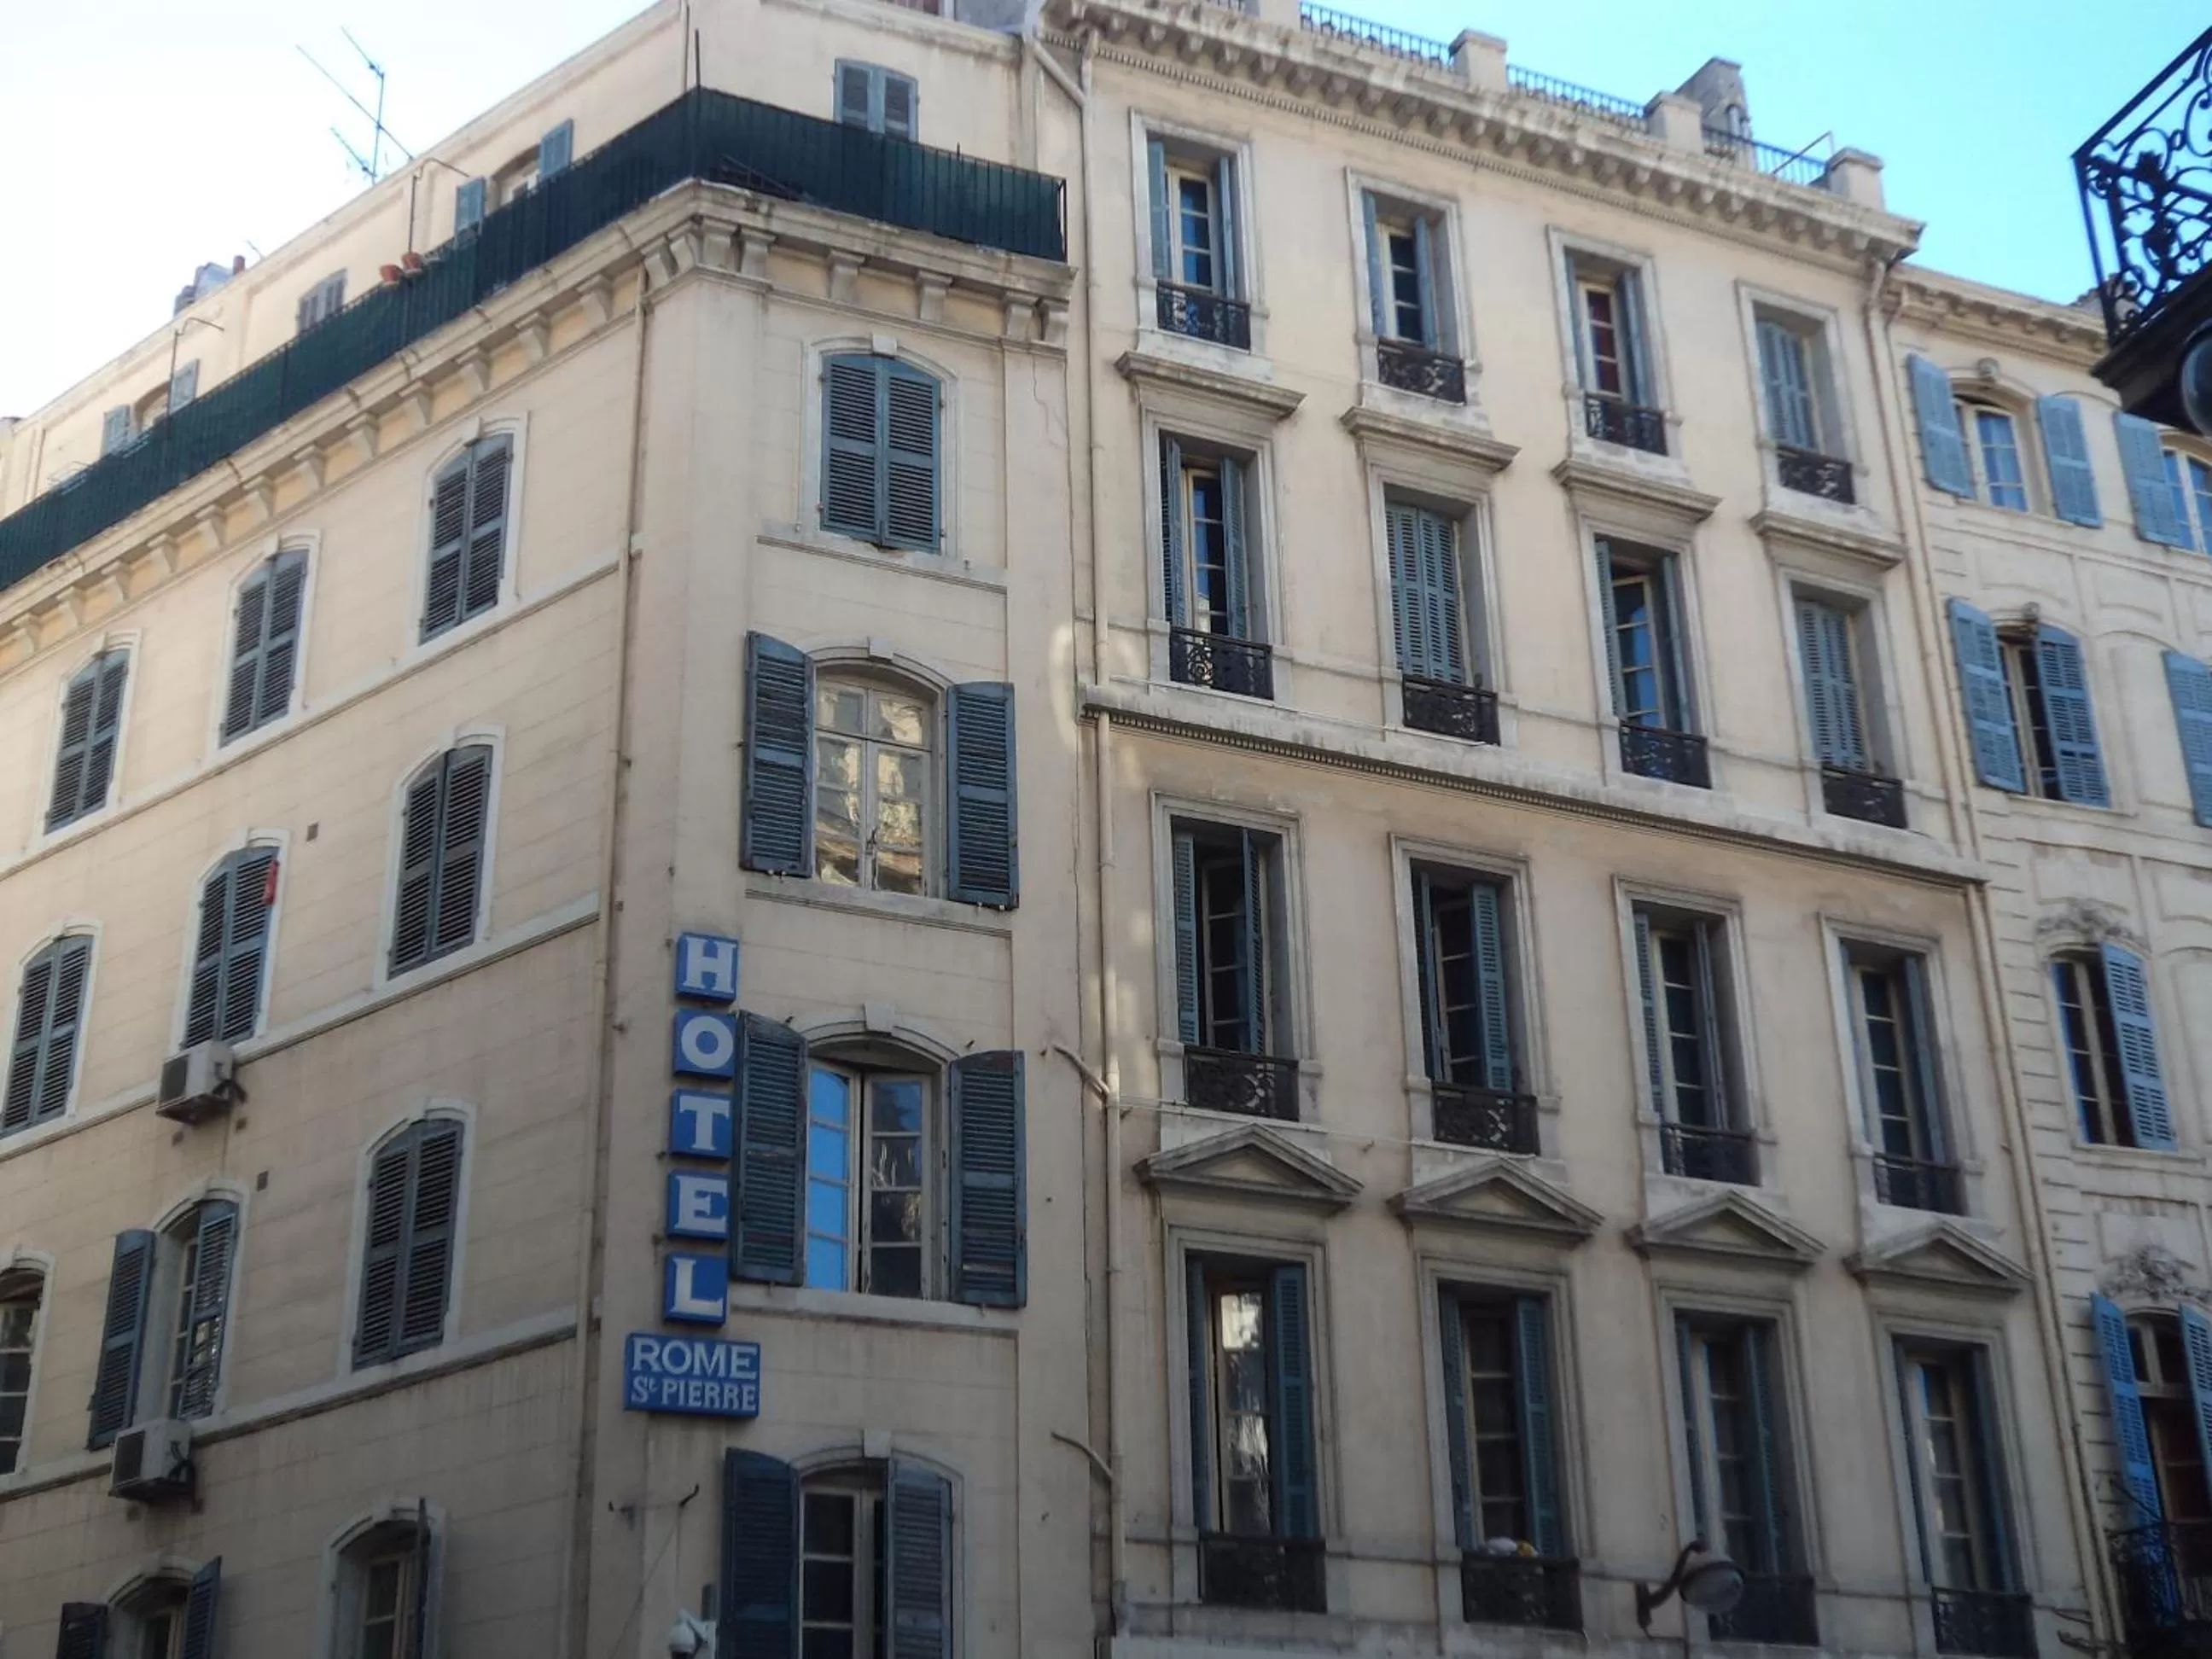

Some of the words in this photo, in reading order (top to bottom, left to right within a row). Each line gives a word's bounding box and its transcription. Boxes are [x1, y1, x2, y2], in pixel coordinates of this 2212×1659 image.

[671, 936, 736, 1317] HOTEL
[632, 1336, 758, 1379] ROME
[631, 1375, 657, 1403] St
[661, 1378, 756, 1411] PIERRE
